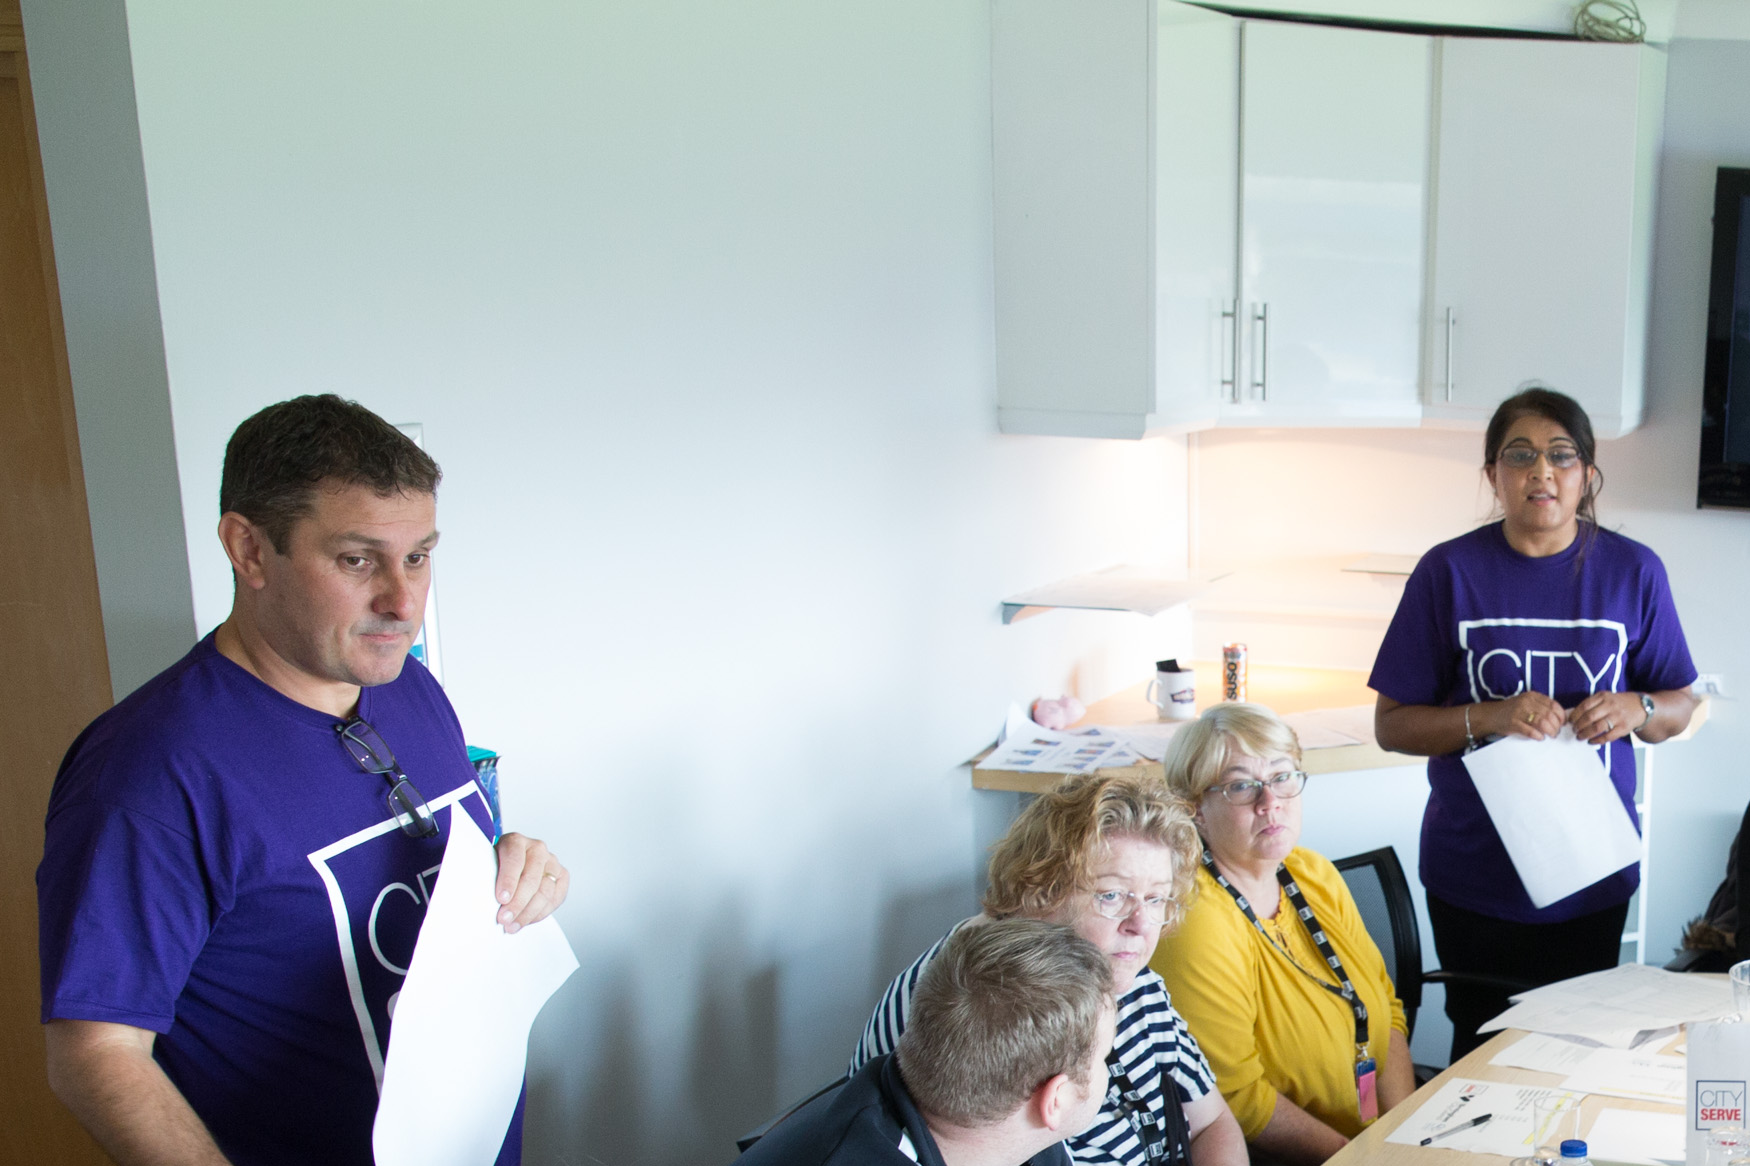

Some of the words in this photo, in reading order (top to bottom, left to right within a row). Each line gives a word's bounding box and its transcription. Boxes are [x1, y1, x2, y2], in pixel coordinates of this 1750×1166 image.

[1478, 648, 1615, 700] CITY
[1700, 1090, 1743, 1107] CITY
[1700, 1108, 1741, 1121] SERVE
